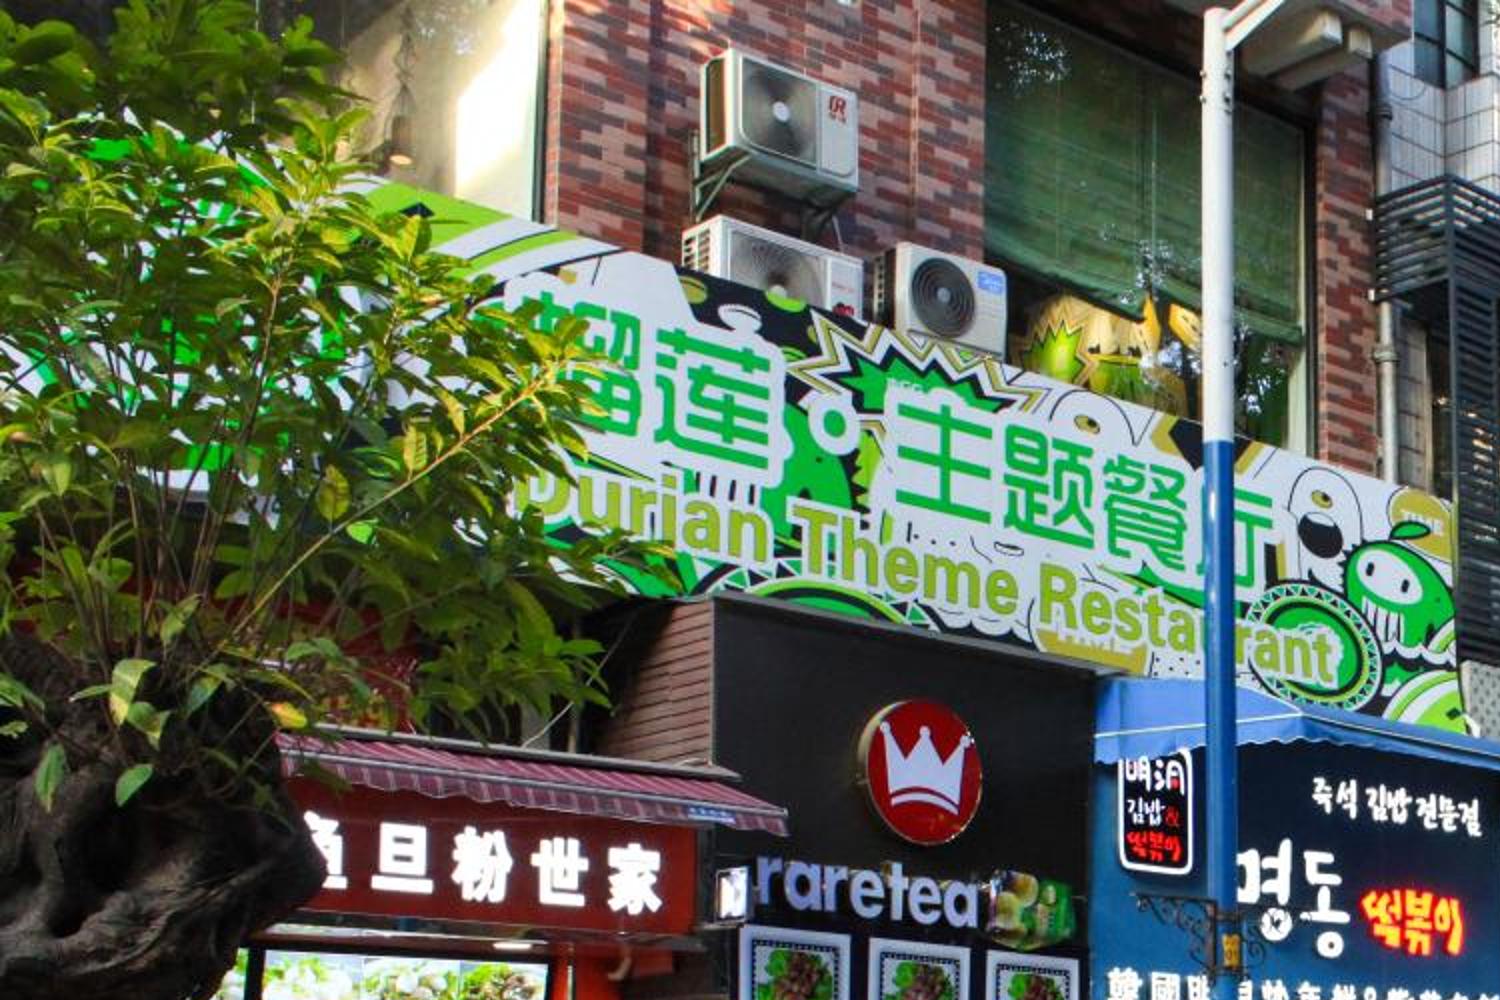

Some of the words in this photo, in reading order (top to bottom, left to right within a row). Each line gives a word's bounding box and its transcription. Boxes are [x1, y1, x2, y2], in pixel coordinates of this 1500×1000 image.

[514, 466, 769, 565] Durian
[791, 503, 1019, 616] Theme
[1040, 562, 1332, 683] Restarant
[1365, 783, 1413, 825] 김밥
[756, 856, 979, 930] raretea
[1236, 837, 1351, 958] 명동
[1360, 888, 1464, 957] 떡볶이
